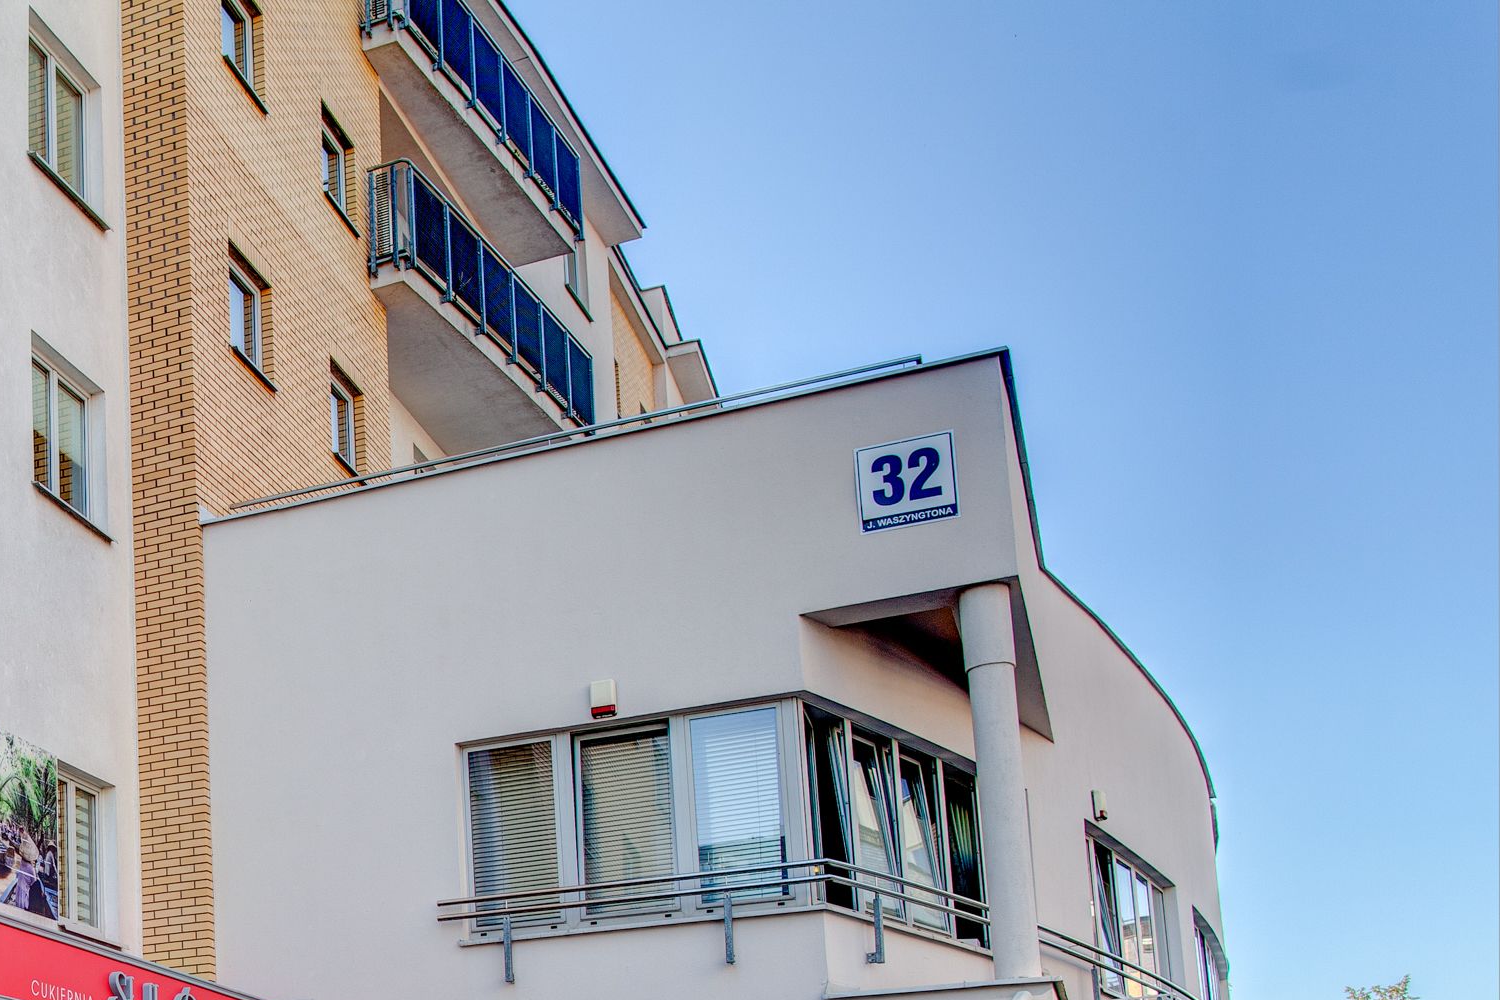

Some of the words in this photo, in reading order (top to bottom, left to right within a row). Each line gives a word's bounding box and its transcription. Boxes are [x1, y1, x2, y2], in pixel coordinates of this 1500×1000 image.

[871, 447, 942, 506] 32
[867, 521, 876, 529] J.
[877, 506, 953, 528] WASZYNGTONA
